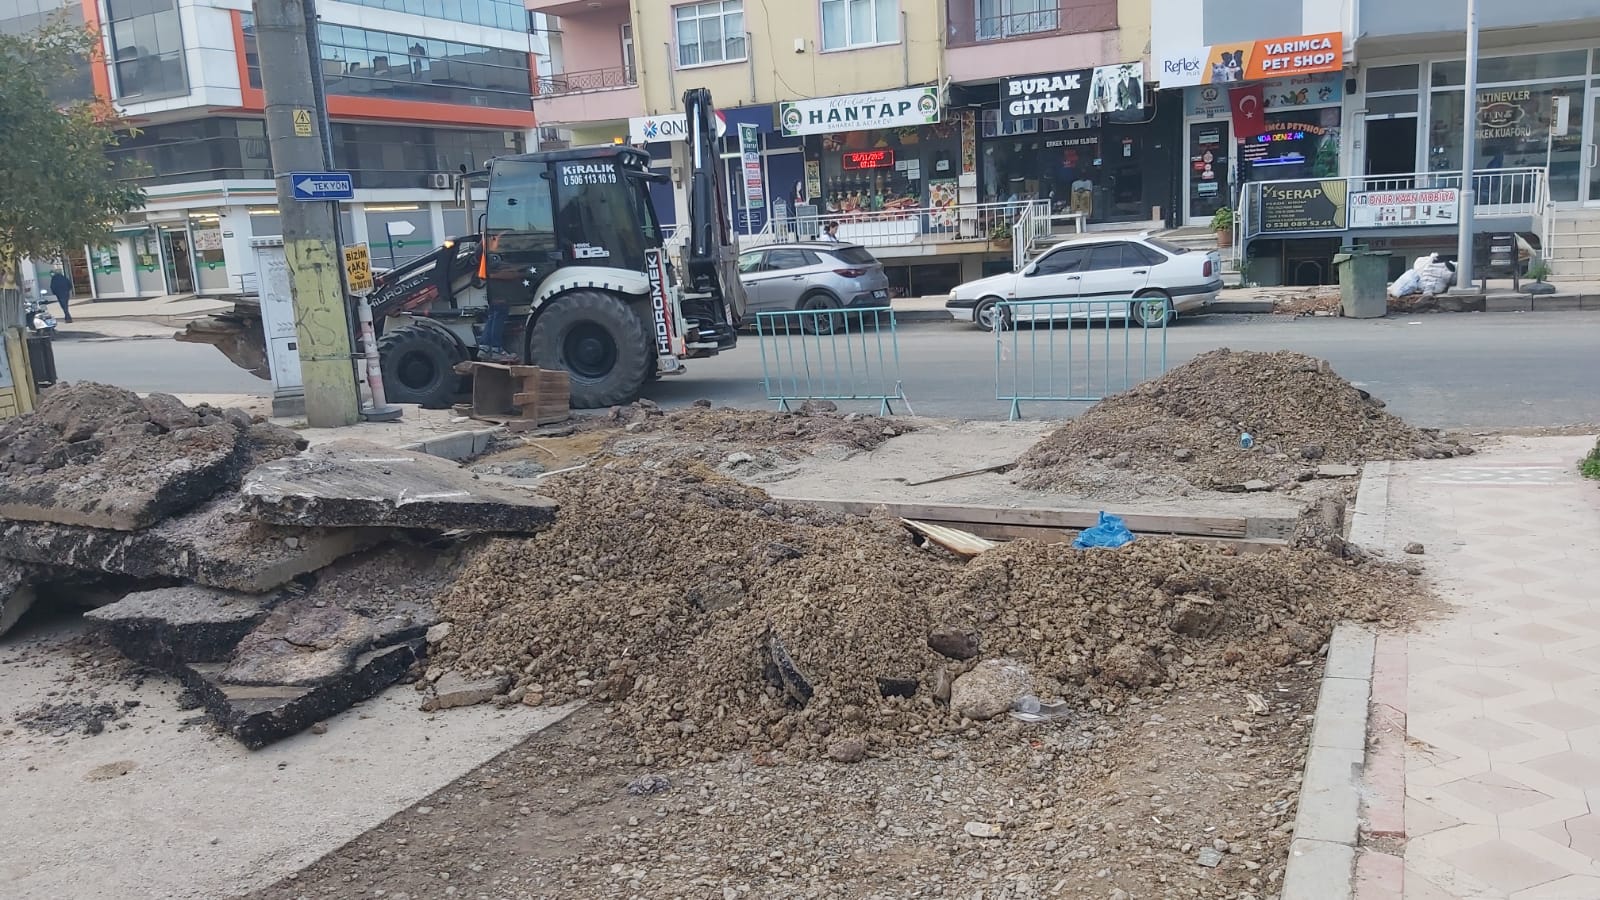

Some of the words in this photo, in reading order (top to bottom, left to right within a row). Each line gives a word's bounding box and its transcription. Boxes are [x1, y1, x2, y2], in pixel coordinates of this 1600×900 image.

[1264, 38, 1332, 55] YARIMCA
[1164, 58, 1200, 75] Reflex
[1262, 56, 1290, 70] PET
[1294, 53, 1335, 68] SHOP
[1008, 74, 1080, 96] BURAK
[809, 102, 912, 124] HANTAP
[1009, 94, 1070, 116] GİYİM
[314, 182, 329, 190] TEK
[564, 175, 569, 186] 0
[570, 175, 583, 185] 506
[584, 174, 597, 184] 113
[598, 174, 606, 183] 10
[608, 173, 616, 184] 19
[1278, 188, 1322, 200] SERAP
[1369, 194, 1393, 205] ONUR
